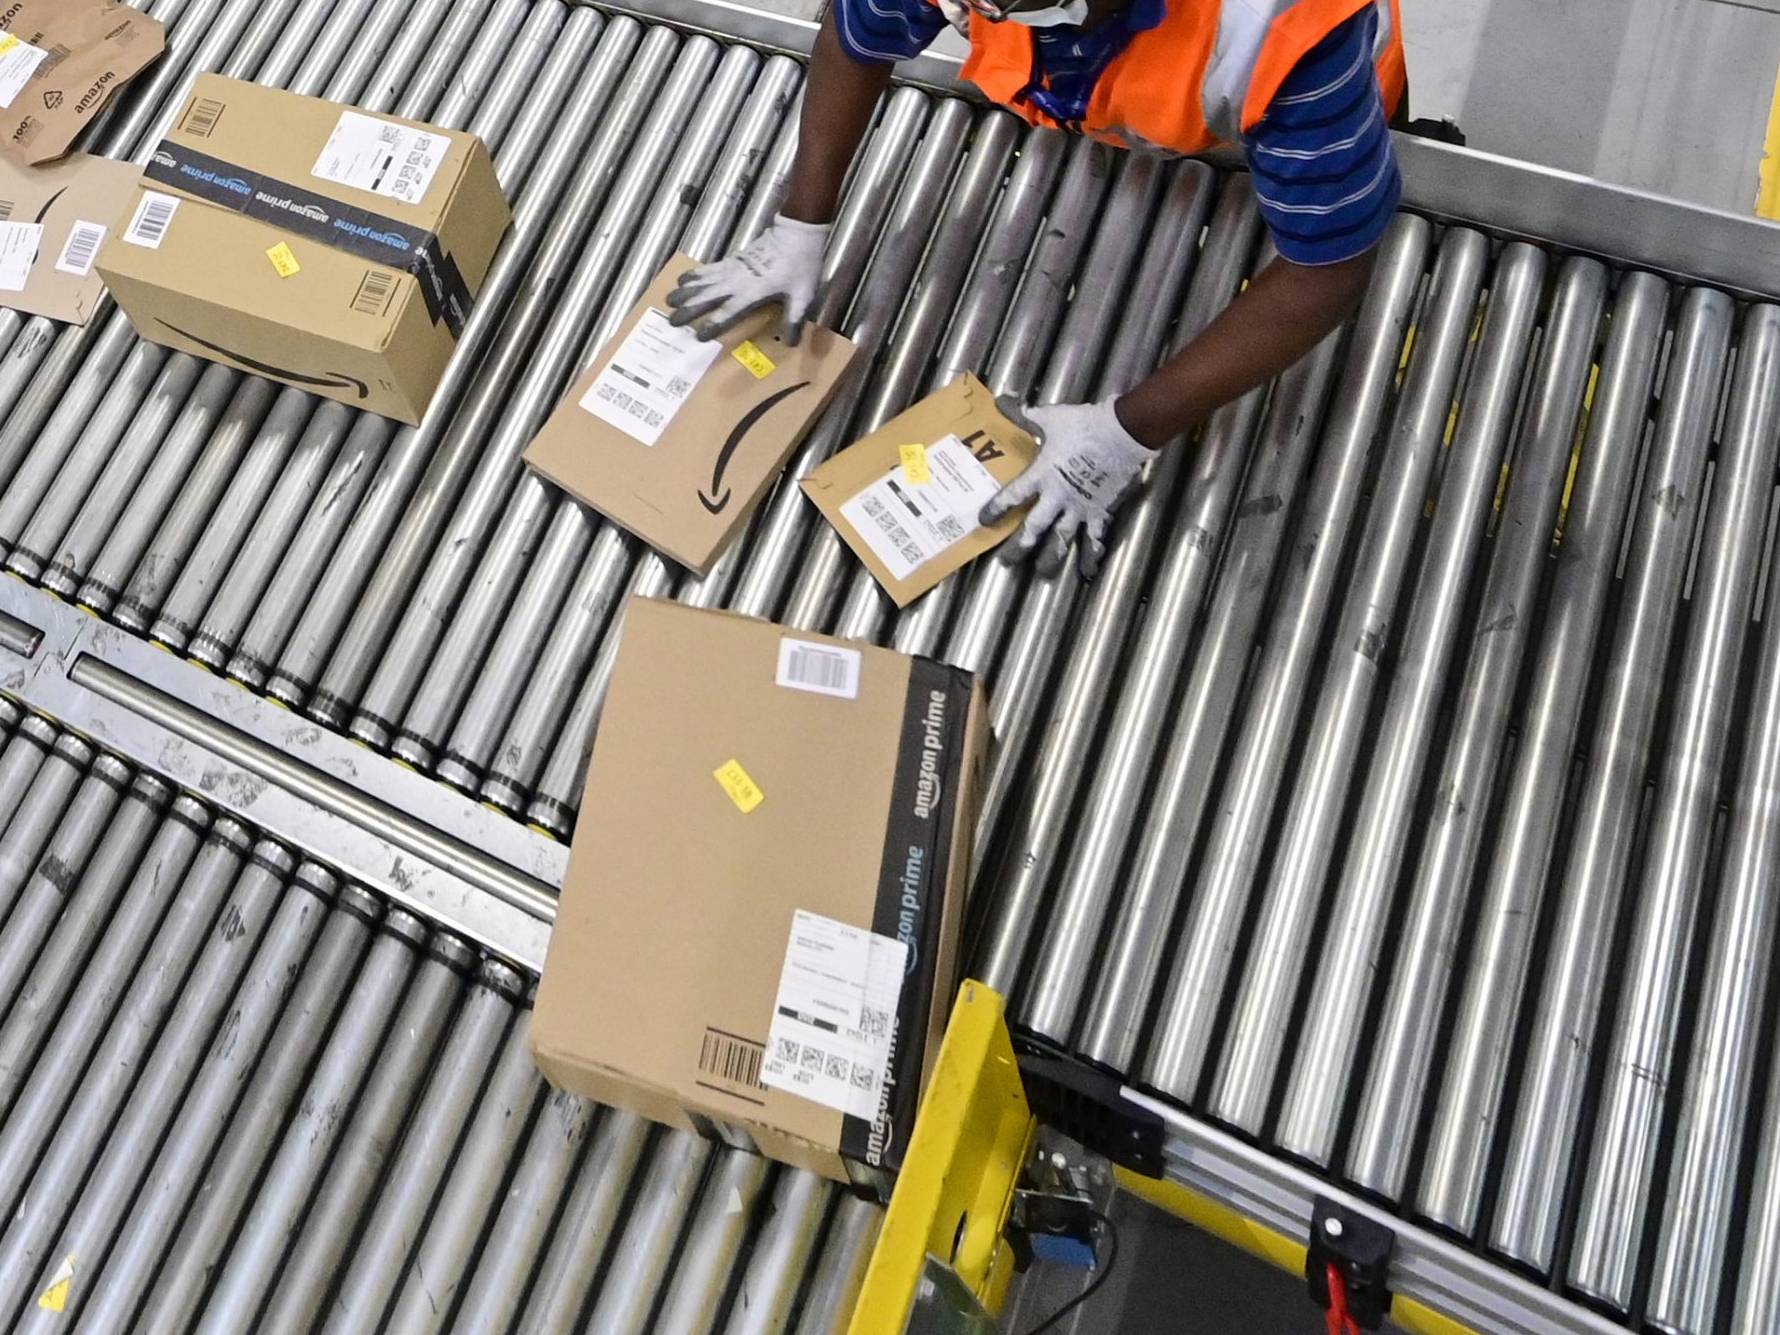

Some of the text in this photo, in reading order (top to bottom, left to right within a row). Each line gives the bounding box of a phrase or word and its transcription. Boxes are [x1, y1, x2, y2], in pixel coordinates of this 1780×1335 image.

[74, 70, 115, 115] amazon
[180, 163, 252, 196] amazon prime
[255, 190, 329, 224] amazon prime
[333, 217, 410, 251] amazon prime
[962, 429, 1005, 463] A1
[914, 690, 947, 819] amazon prime
[896, 845, 924, 946] zon prime
